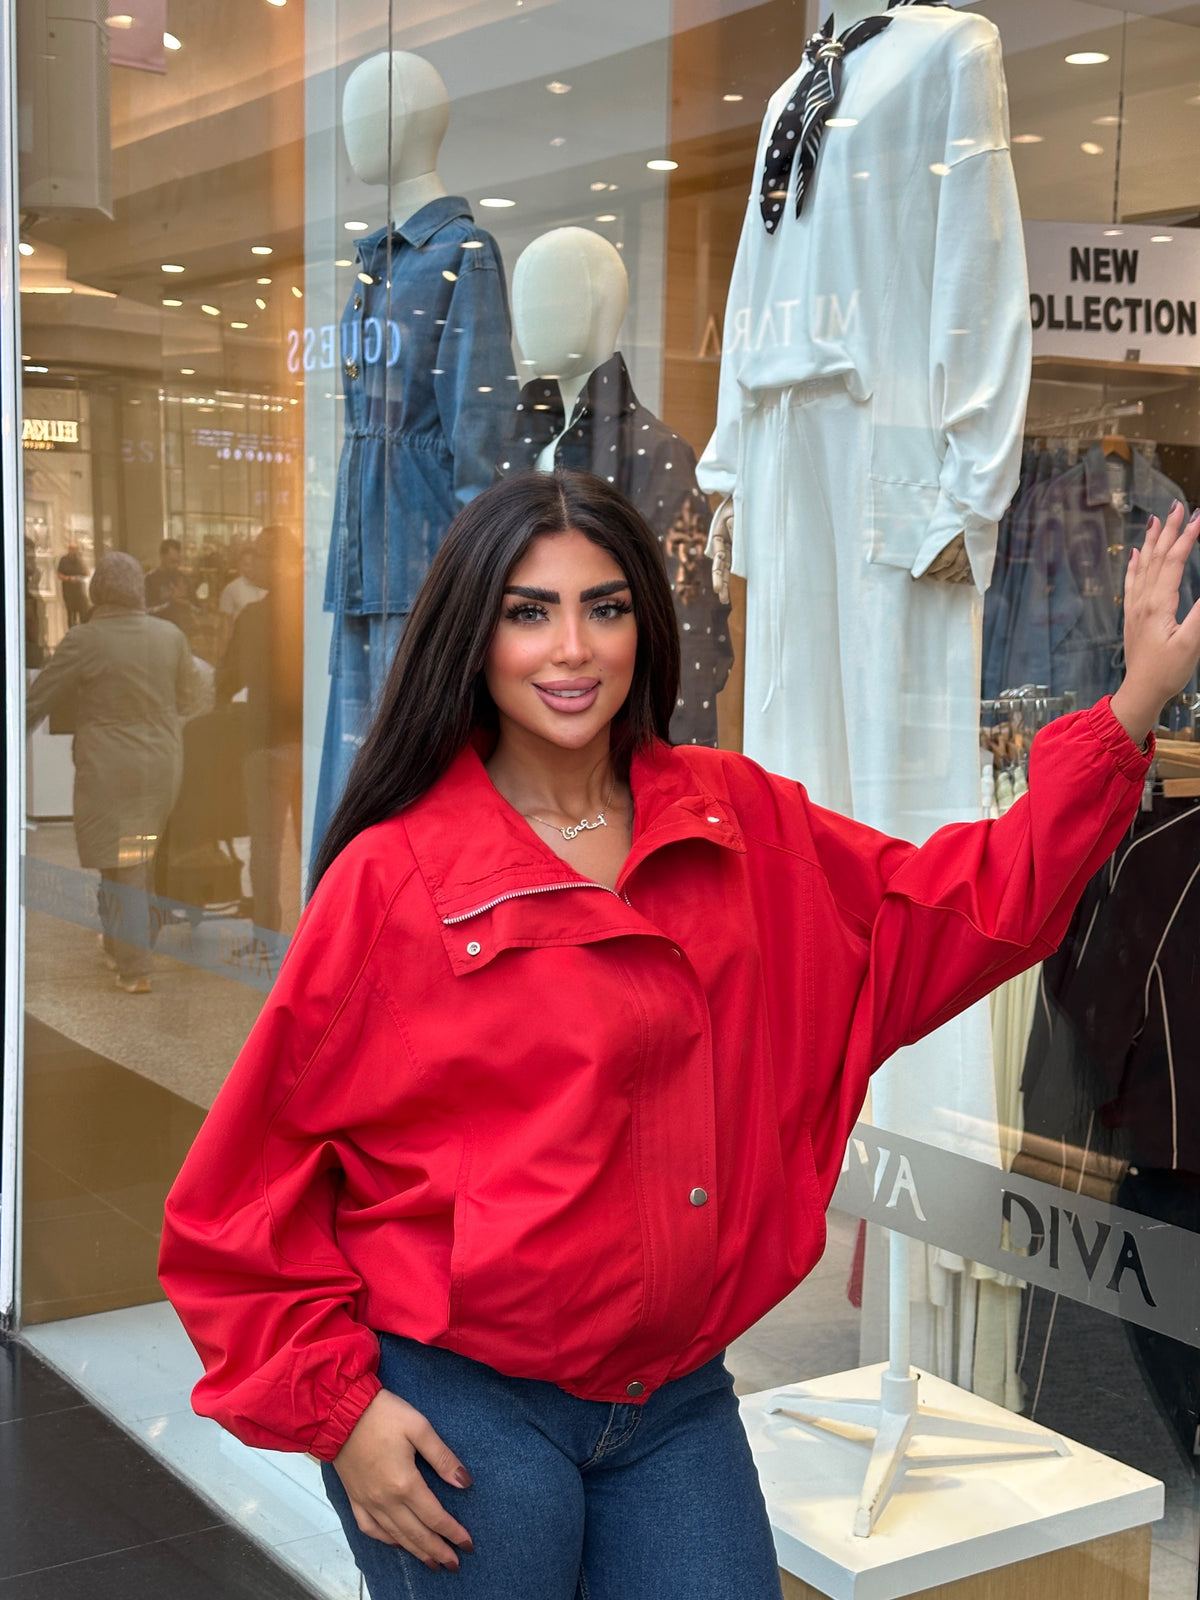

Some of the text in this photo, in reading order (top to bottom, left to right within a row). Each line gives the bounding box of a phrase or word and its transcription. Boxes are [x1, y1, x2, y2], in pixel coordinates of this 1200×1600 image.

[1070, 246, 1139, 283] NEW
[1029, 293, 1197, 336] OLLECTION
[1000, 1188, 1157, 1308] DIVA
